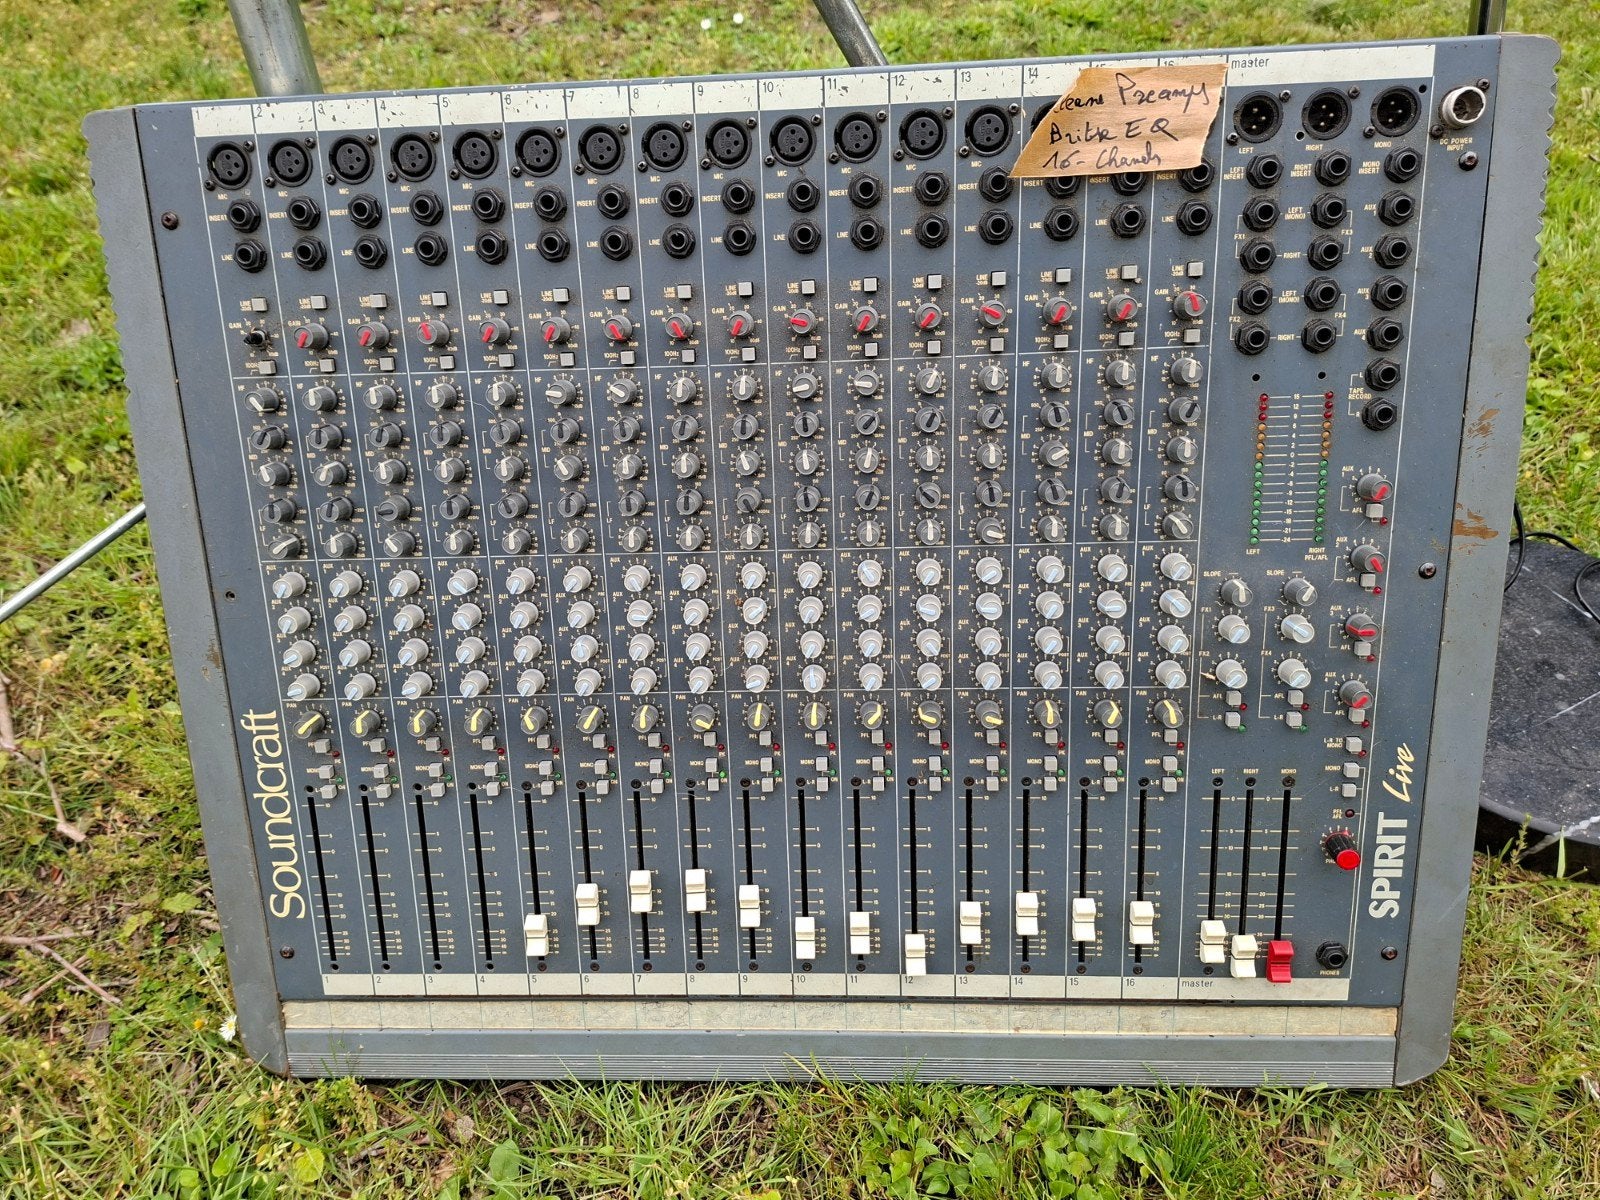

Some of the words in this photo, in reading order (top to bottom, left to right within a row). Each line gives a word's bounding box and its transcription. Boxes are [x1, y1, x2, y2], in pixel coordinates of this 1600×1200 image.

[1231, 57, 1270, 70] master
[961, 71, 972, 83] 13
[1028, 68, 1038, 79] 14
[827, 79, 837, 90] 11
[894, 75, 905, 87] 12
[698, 85, 704, 96] 9
[763, 82, 774, 93] 10
[568, 91, 574, 102] 7
[633, 88, 639, 99] 8
[442, 97, 449, 108] 5
[504, 94, 511, 105] 6
[318, 104, 326, 115] 3
[380, 100, 387, 111] 4
[195, 110, 200, 120] 1
[255, 107, 263, 118] 2
[1450, 137, 1473, 145] POWER
[1230, 166, 1244, 174] LEFT
[1294, 163, 1312, 171] RIGHT
[1358, 167, 1379, 175] INSERT
[1290, 169, 1311, 178] INSERT
[1382, 742, 1415, 803] Live
[241, 709, 305, 918] Soundcraft
[1369, 811, 1407, 919] SPIRIT
[584, 975, 589, 983] 6
[637, 975, 642, 983] 7
[690, 975, 695, 983] 8
[743, 975, 748, 983] 9
[904, 976, 914, 984] 12
[959, 976, 968, 984] 13
[1014, 977, 1023, 985] 14
[1070, 978, 1079, 986] 15
[1126, 978, 1135, 986] 16
[1182, 980, 1213, 988] master
